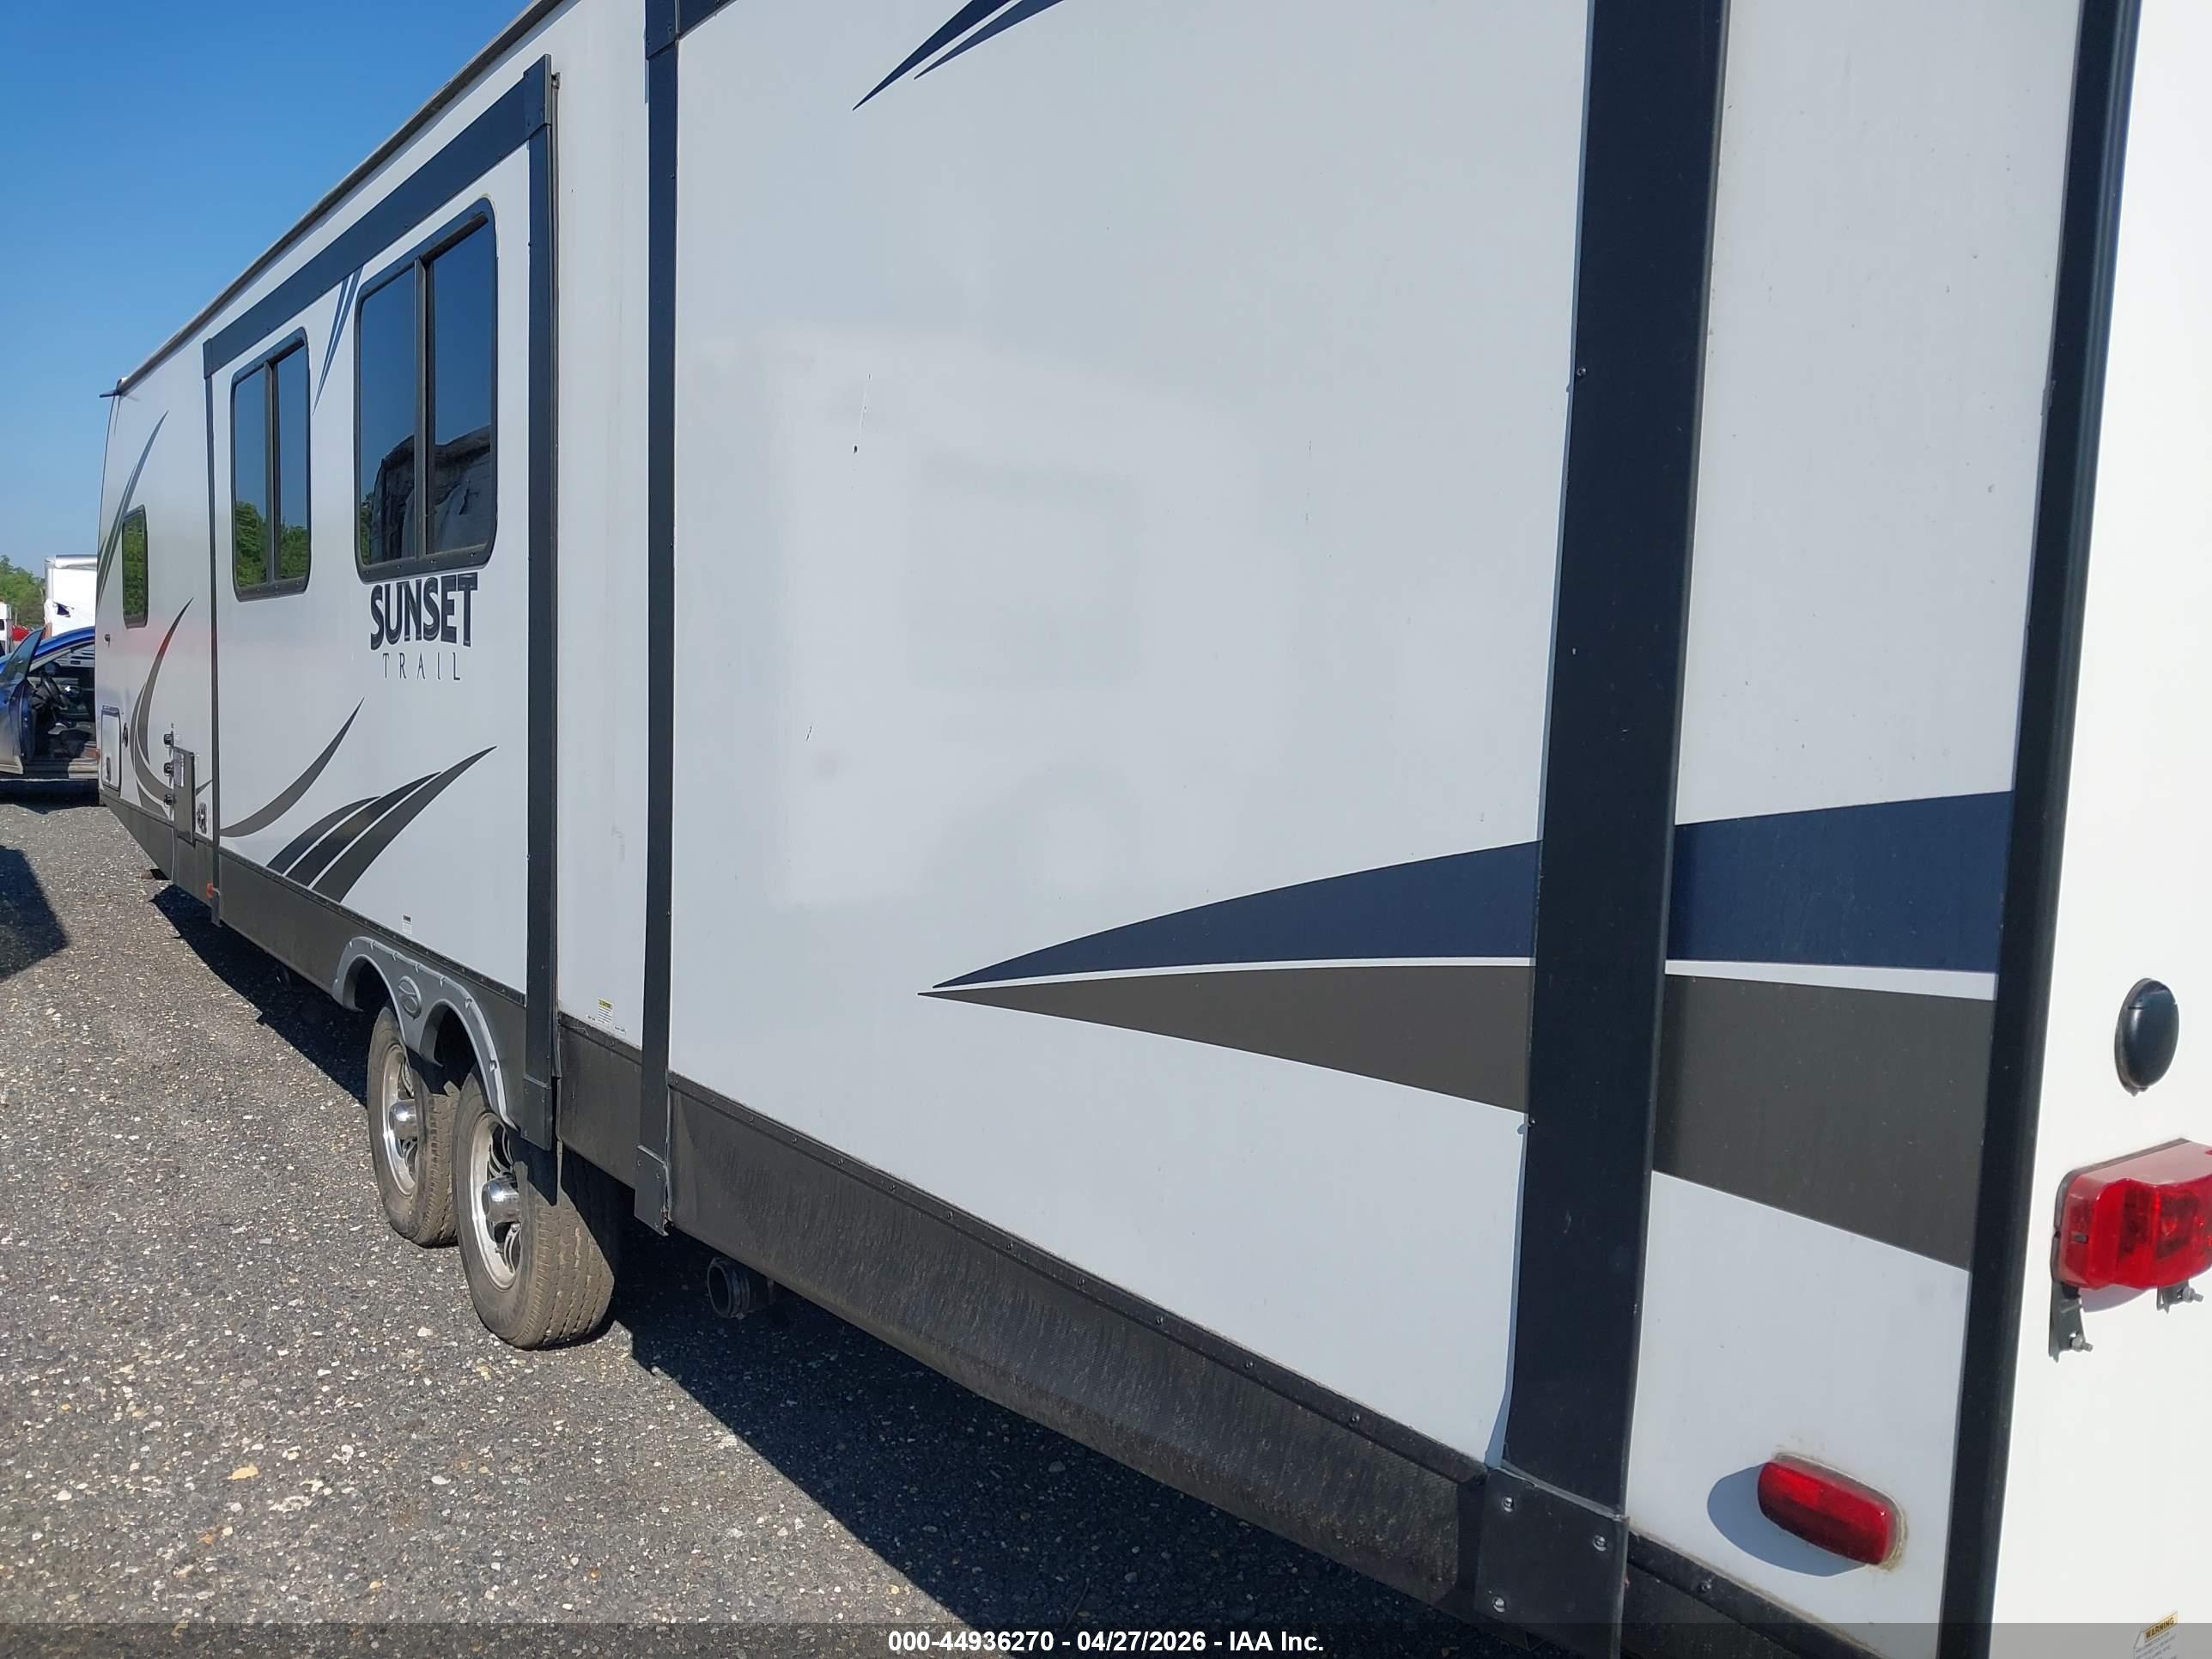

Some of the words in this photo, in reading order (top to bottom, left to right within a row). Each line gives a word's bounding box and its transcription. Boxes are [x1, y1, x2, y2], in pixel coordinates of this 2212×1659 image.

[370, 572, 478, 650] SUNSET
[382, 653, 461, 680] TRAIL
[2146, 1617, 2174, 1638] WARNING
